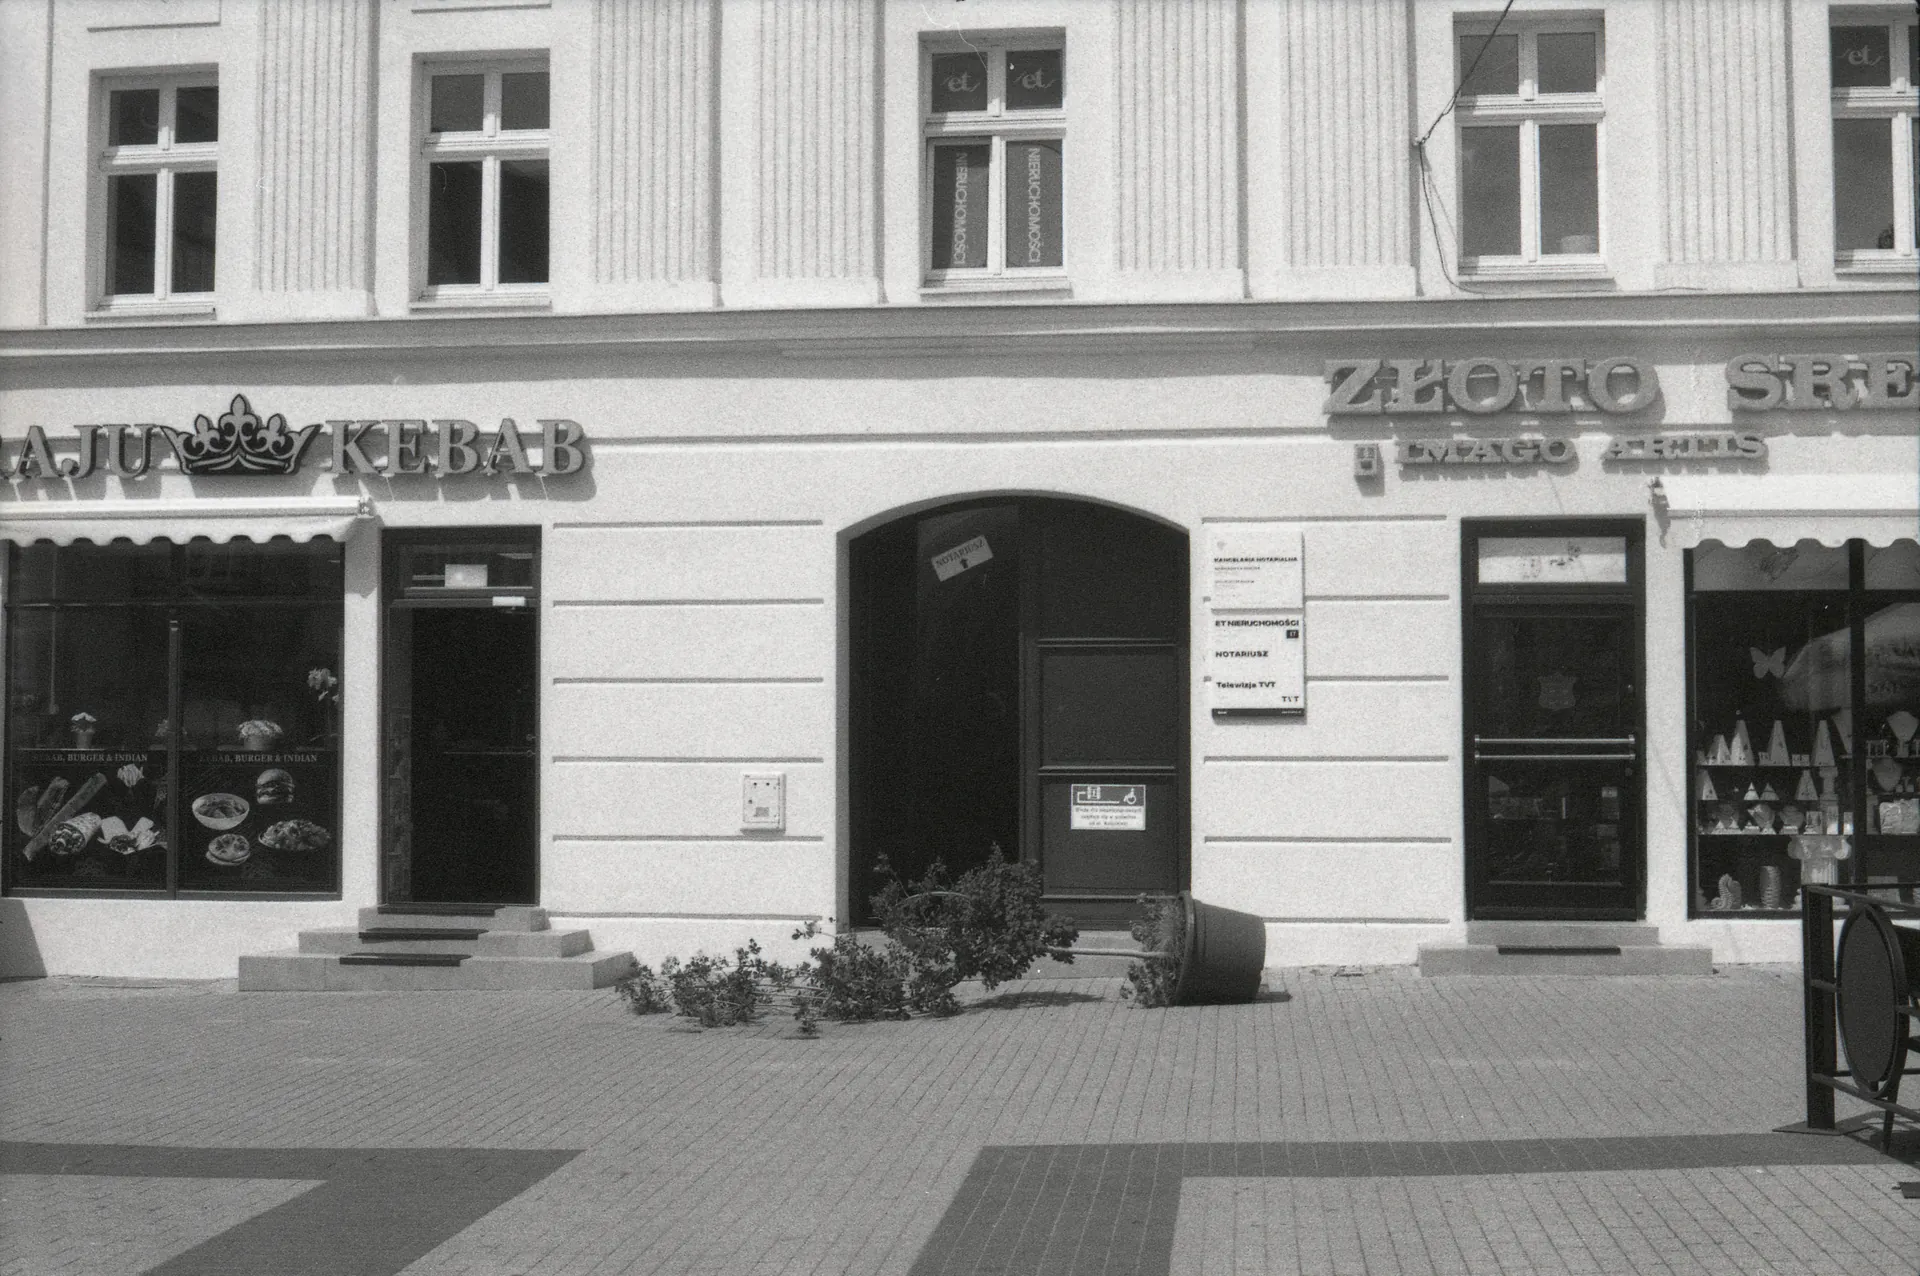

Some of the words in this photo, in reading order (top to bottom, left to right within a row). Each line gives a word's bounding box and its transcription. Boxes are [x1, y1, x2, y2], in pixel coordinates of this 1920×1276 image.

[953, 152, 969, 265] NIERUCHOMOŚCI
[1028, 148, 1044, 263] NIERUCHOMOŚCI
[1322, 357, 1653, 413] ZŁOTO
[0, 424, 156, 479] AJU
[324, 418, 586, 475] KEBAB
[1396, 437, 1573, 464] IMAGO
[1604, 433, 1767, 460] ARTIS
[1227, 618, 1299, 627] NIERUCHOMOŚCI
[1215, 650, 1269, 658] NOTARIUSZ
[1216, 681, 1257, 689] Telewizja
[67, 753, 105, 762] BURGER
[114, 753, 148, 762] INDIAN
[235, 754, 273, 762] BURGER
[283, 754, 317, 762] INDIAN
